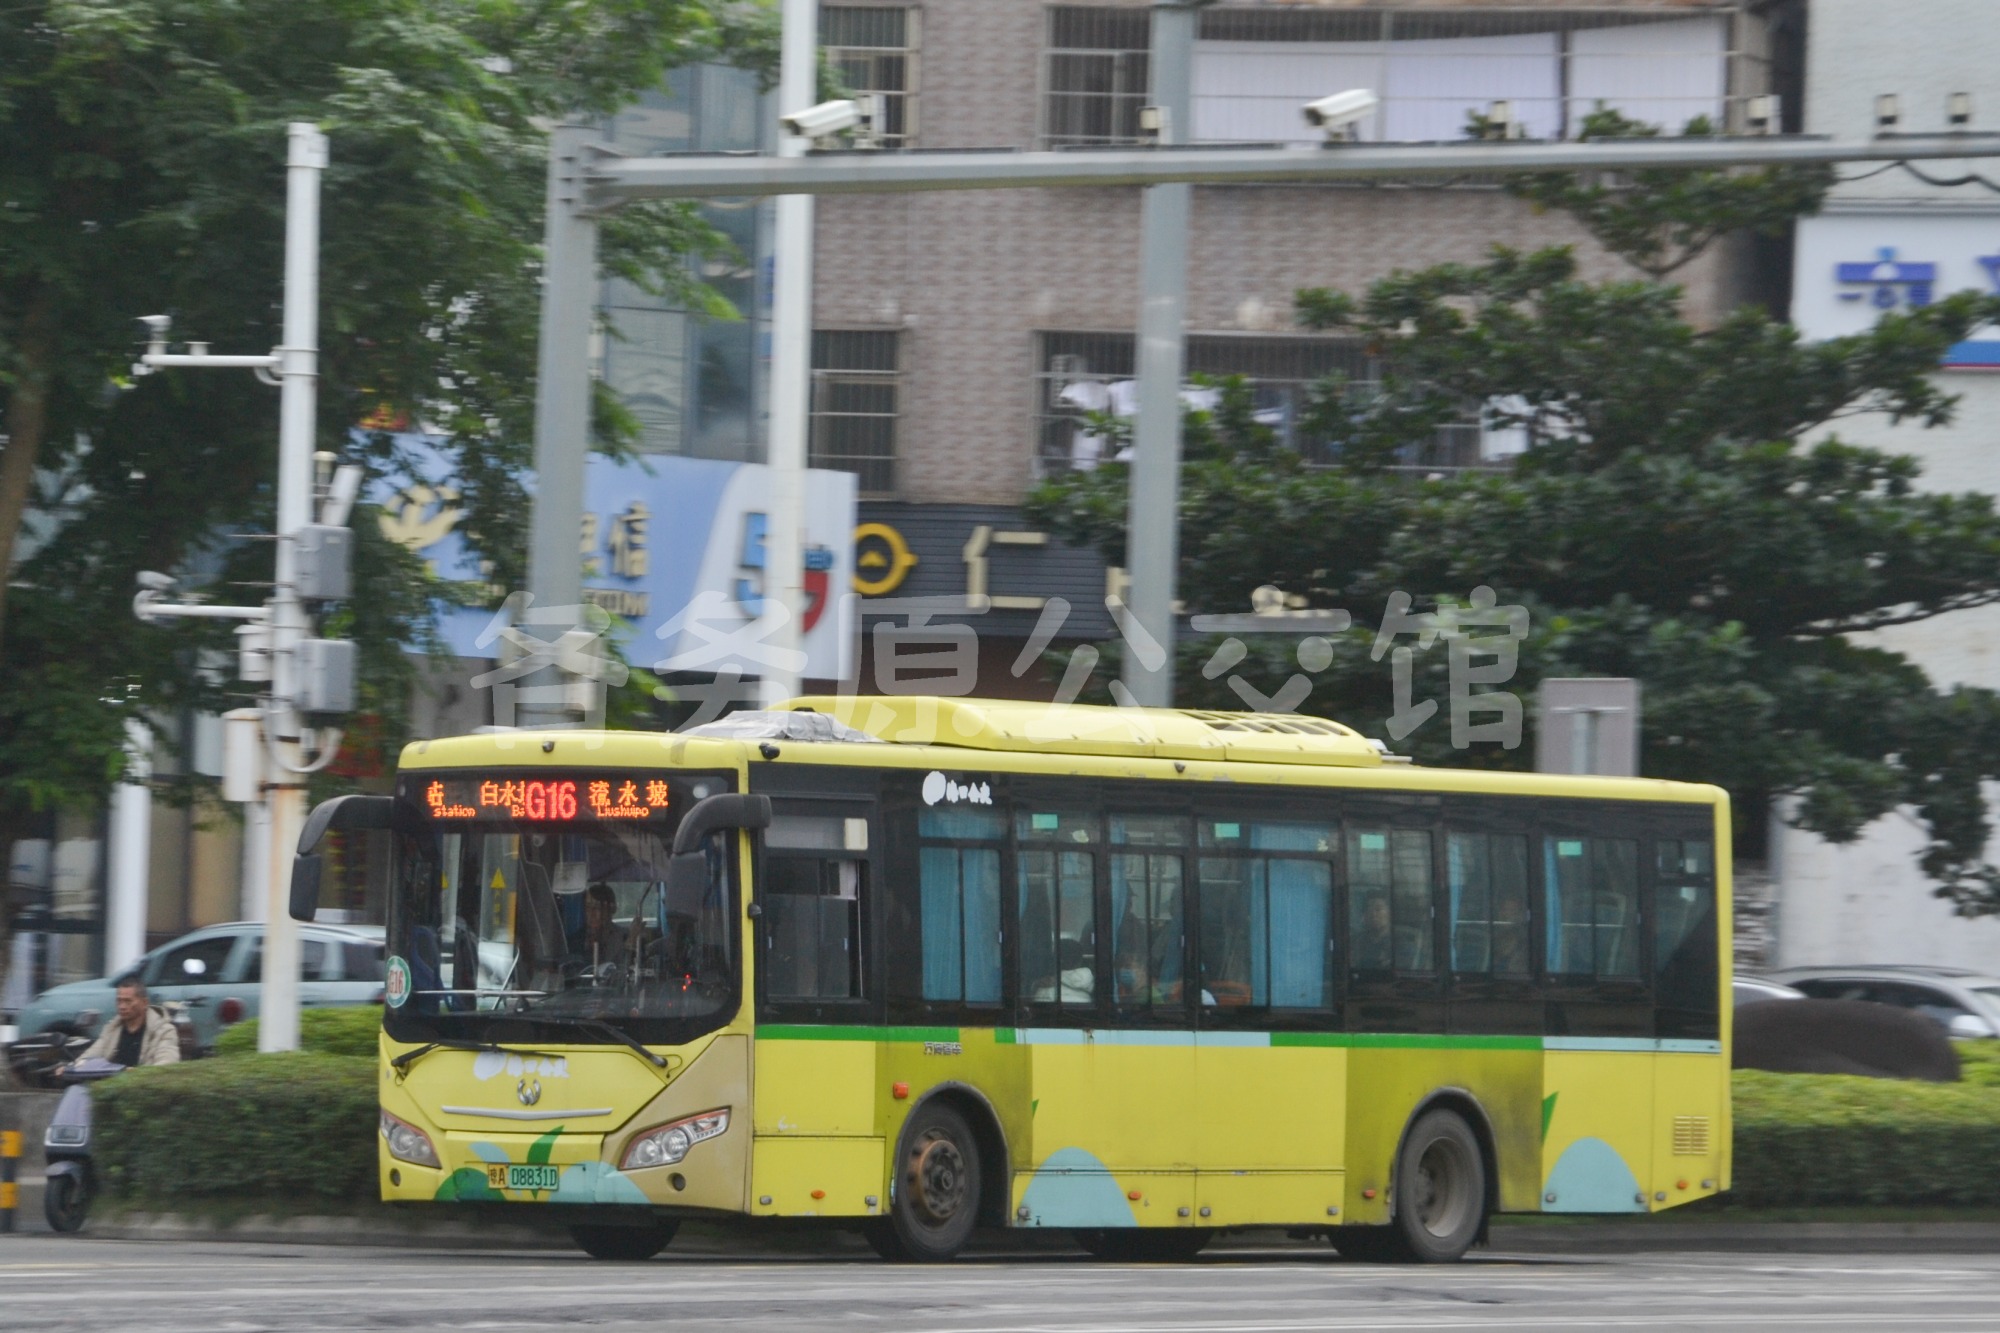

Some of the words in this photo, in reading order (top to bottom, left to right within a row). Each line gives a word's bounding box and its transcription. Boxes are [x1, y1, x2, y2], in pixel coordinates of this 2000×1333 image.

[526, 781, 576, 819] G16
[589, 780, 668, 806] 流水坡
